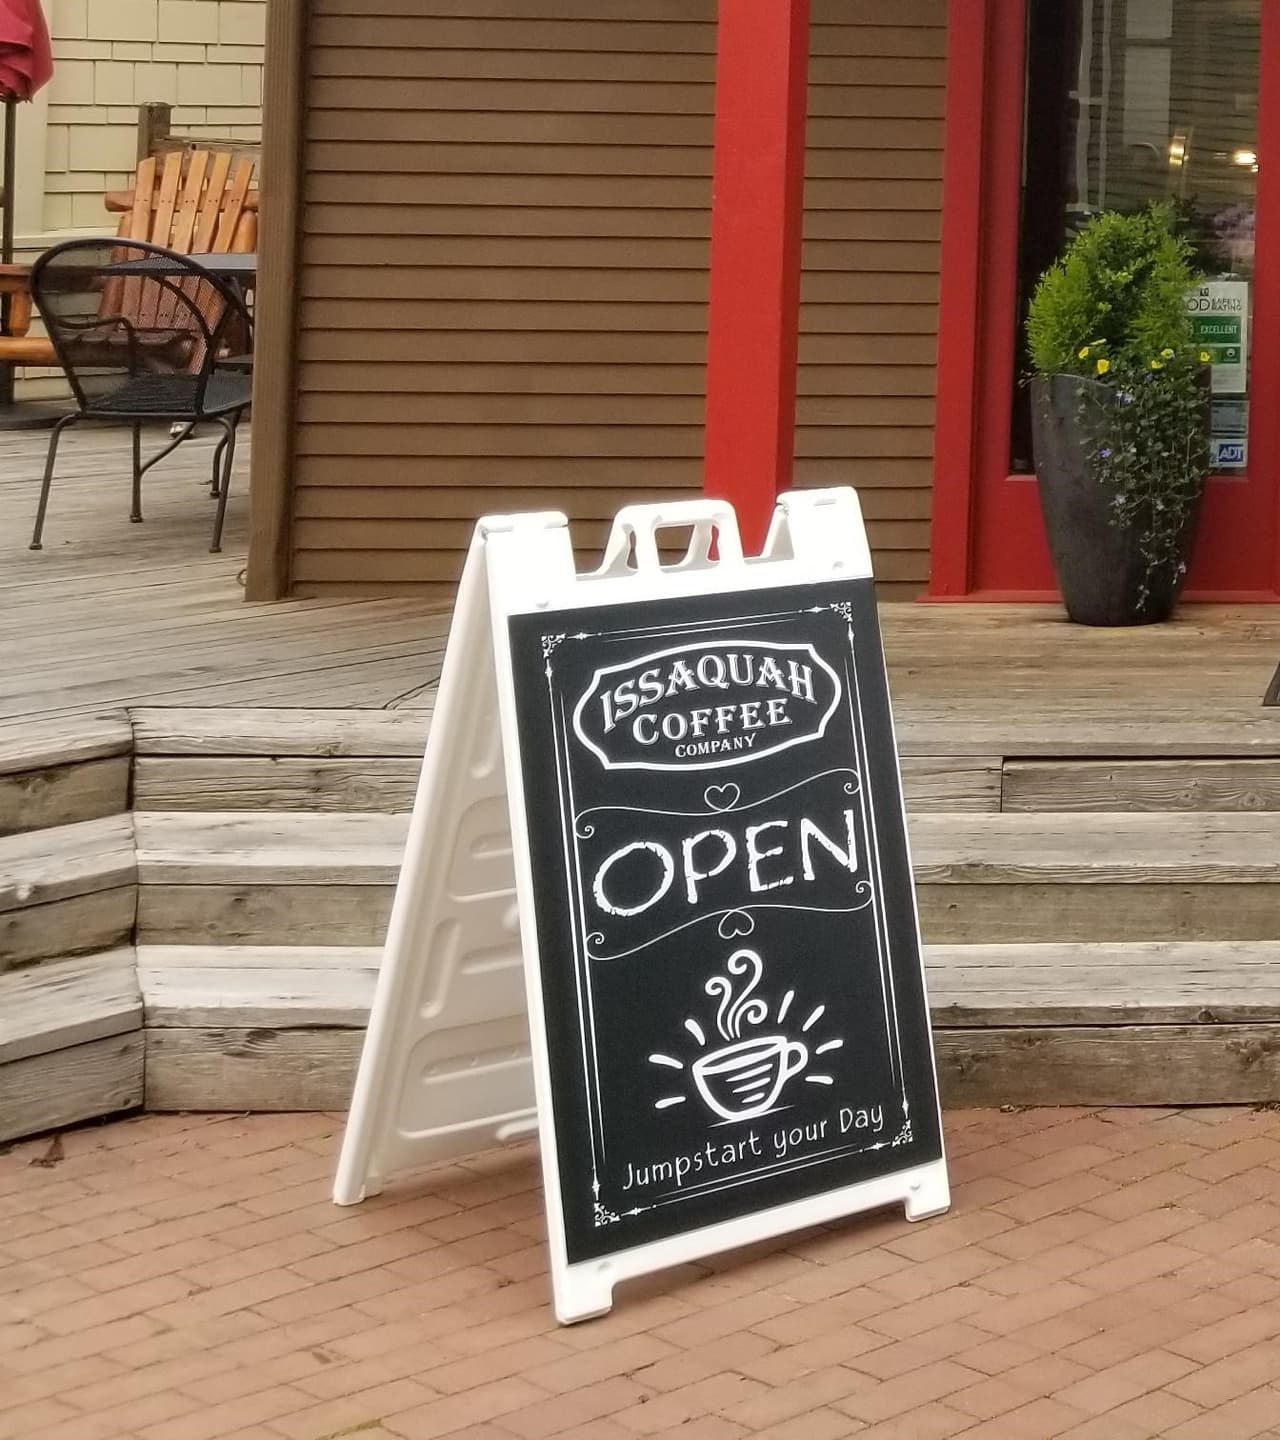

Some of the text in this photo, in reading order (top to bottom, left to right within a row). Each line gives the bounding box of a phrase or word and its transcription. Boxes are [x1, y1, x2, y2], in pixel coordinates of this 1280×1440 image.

[1201, 324, 1237, 334] EXCELLENT
[1219, 444, 1243, 459] ADT
[600, 654, 817, 733] ISSAQUAH
[633, 698, 792, 745] COFFEE
[675, 733, 756, 758] COMPANY
[593, 809, 857, 917] OPEN
[623, 1105, 884, 1190] Jumpstart your Day
